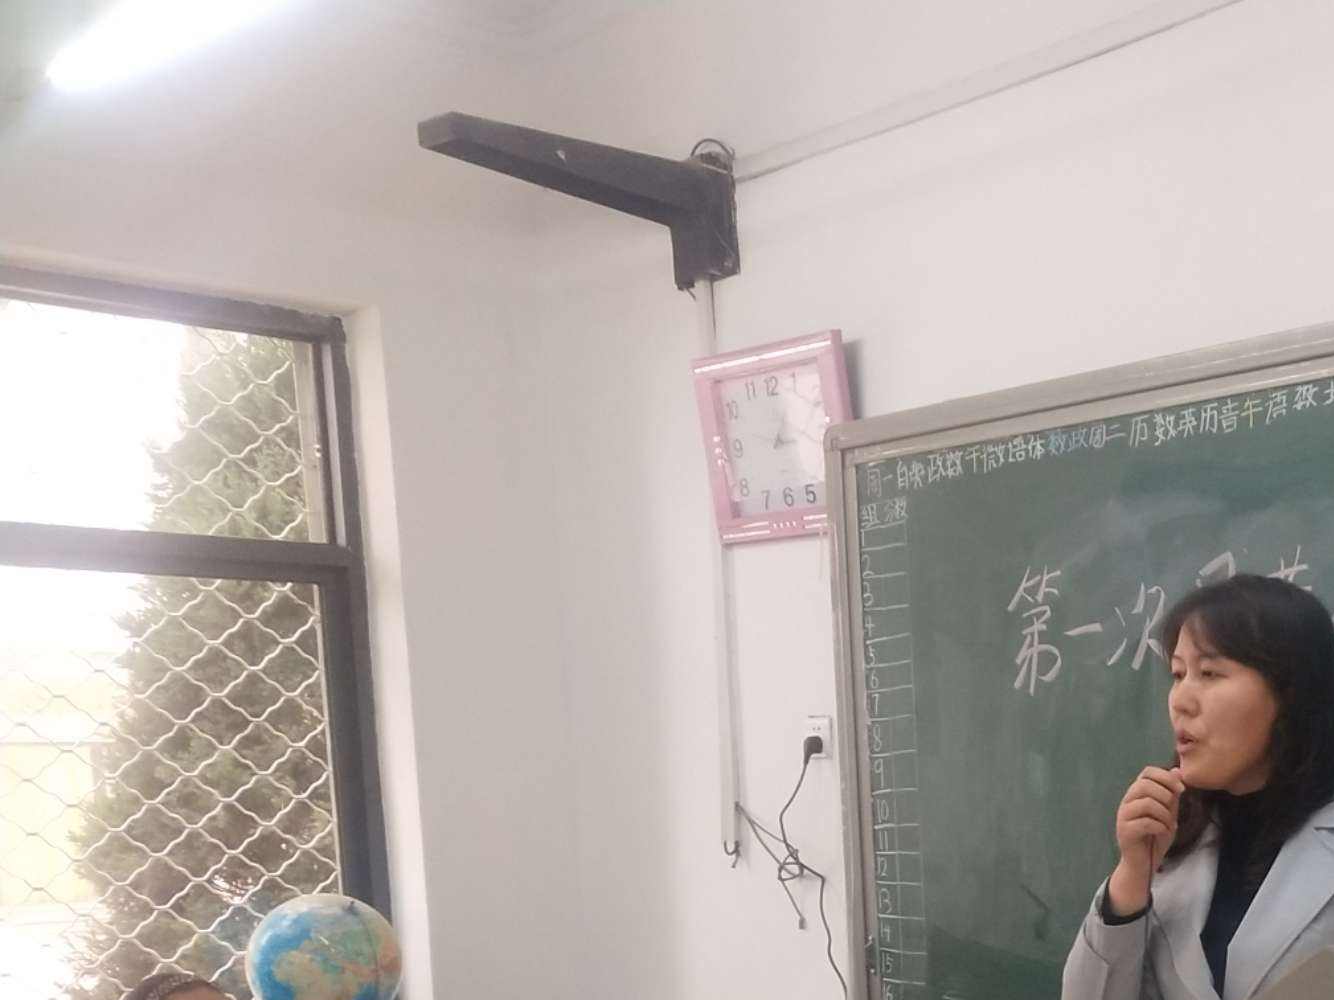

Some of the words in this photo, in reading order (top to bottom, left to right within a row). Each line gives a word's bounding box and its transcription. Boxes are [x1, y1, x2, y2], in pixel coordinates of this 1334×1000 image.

[764, 376, 779, 397] 12
[733, 438, 744, 459] 9
[739, 478, 749, 498] 8
[761, 490, 770, 510] 7
[783, 487, 794, 507] 6
[804, 484, 817, 504] 5
